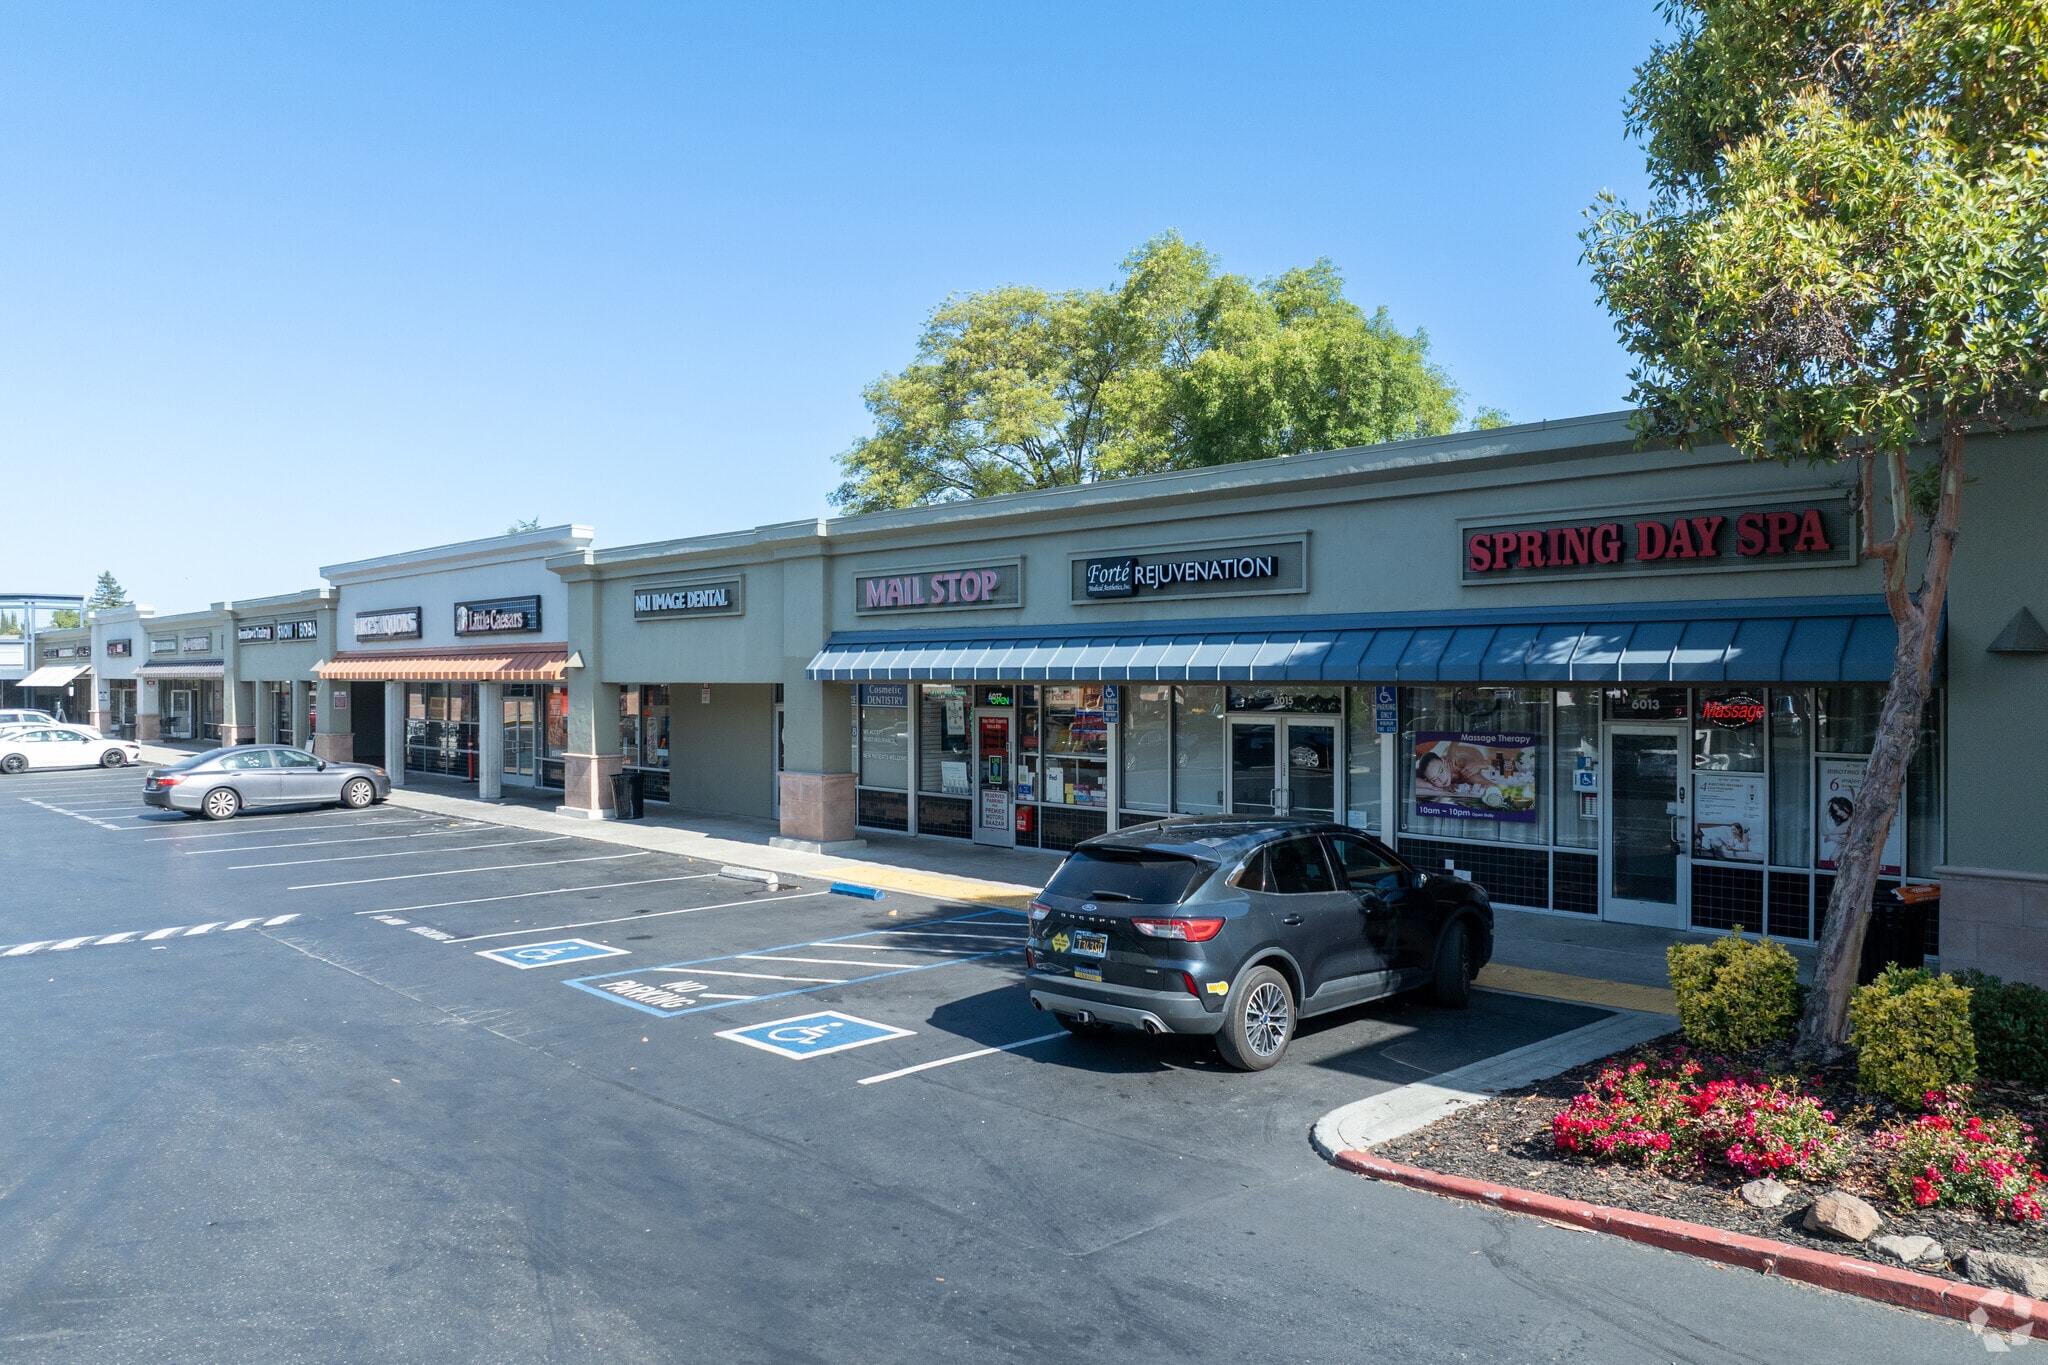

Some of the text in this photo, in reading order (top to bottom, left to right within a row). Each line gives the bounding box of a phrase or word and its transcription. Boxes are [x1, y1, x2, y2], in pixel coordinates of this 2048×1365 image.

[1469, 509, 1831, 573] SPRING DAY SPA
[1087, 561, 1130, 584] Forté
[1134, 556, 1272, 590] REJUVENATION
[865, 571, 997, 608] MAIL STOP
[635, 588, 728, 612] NU IMAGE DENTAL
[468, 609, 523, 631] Little Caesars
[299, 621, 317, 638] BOBA
[868, 684, 902, 695] Cosmetic
[866, 695, 904, 706] DENTISTRY
[990, 697, 1010, 706] OPEN
[1273, 696, 1294, 706] 6015
[1376, 703, 1397, 711] PARKING
[1631, 699, 1660, 710] 6013
[1380, 711, 1393, 719] ONLY
[1702, 700, 1765, 723] Massage
[1460, 733, 1531, 744] Massage Therapy
[1829, 777, 1840, 791] 6
[1419, 806, 1441, 815] 10am
[1448, 808, 1471, 817] 10pm
[659, 979, 709, 994] NO
[598, 980, 697, 1009] PARKING
